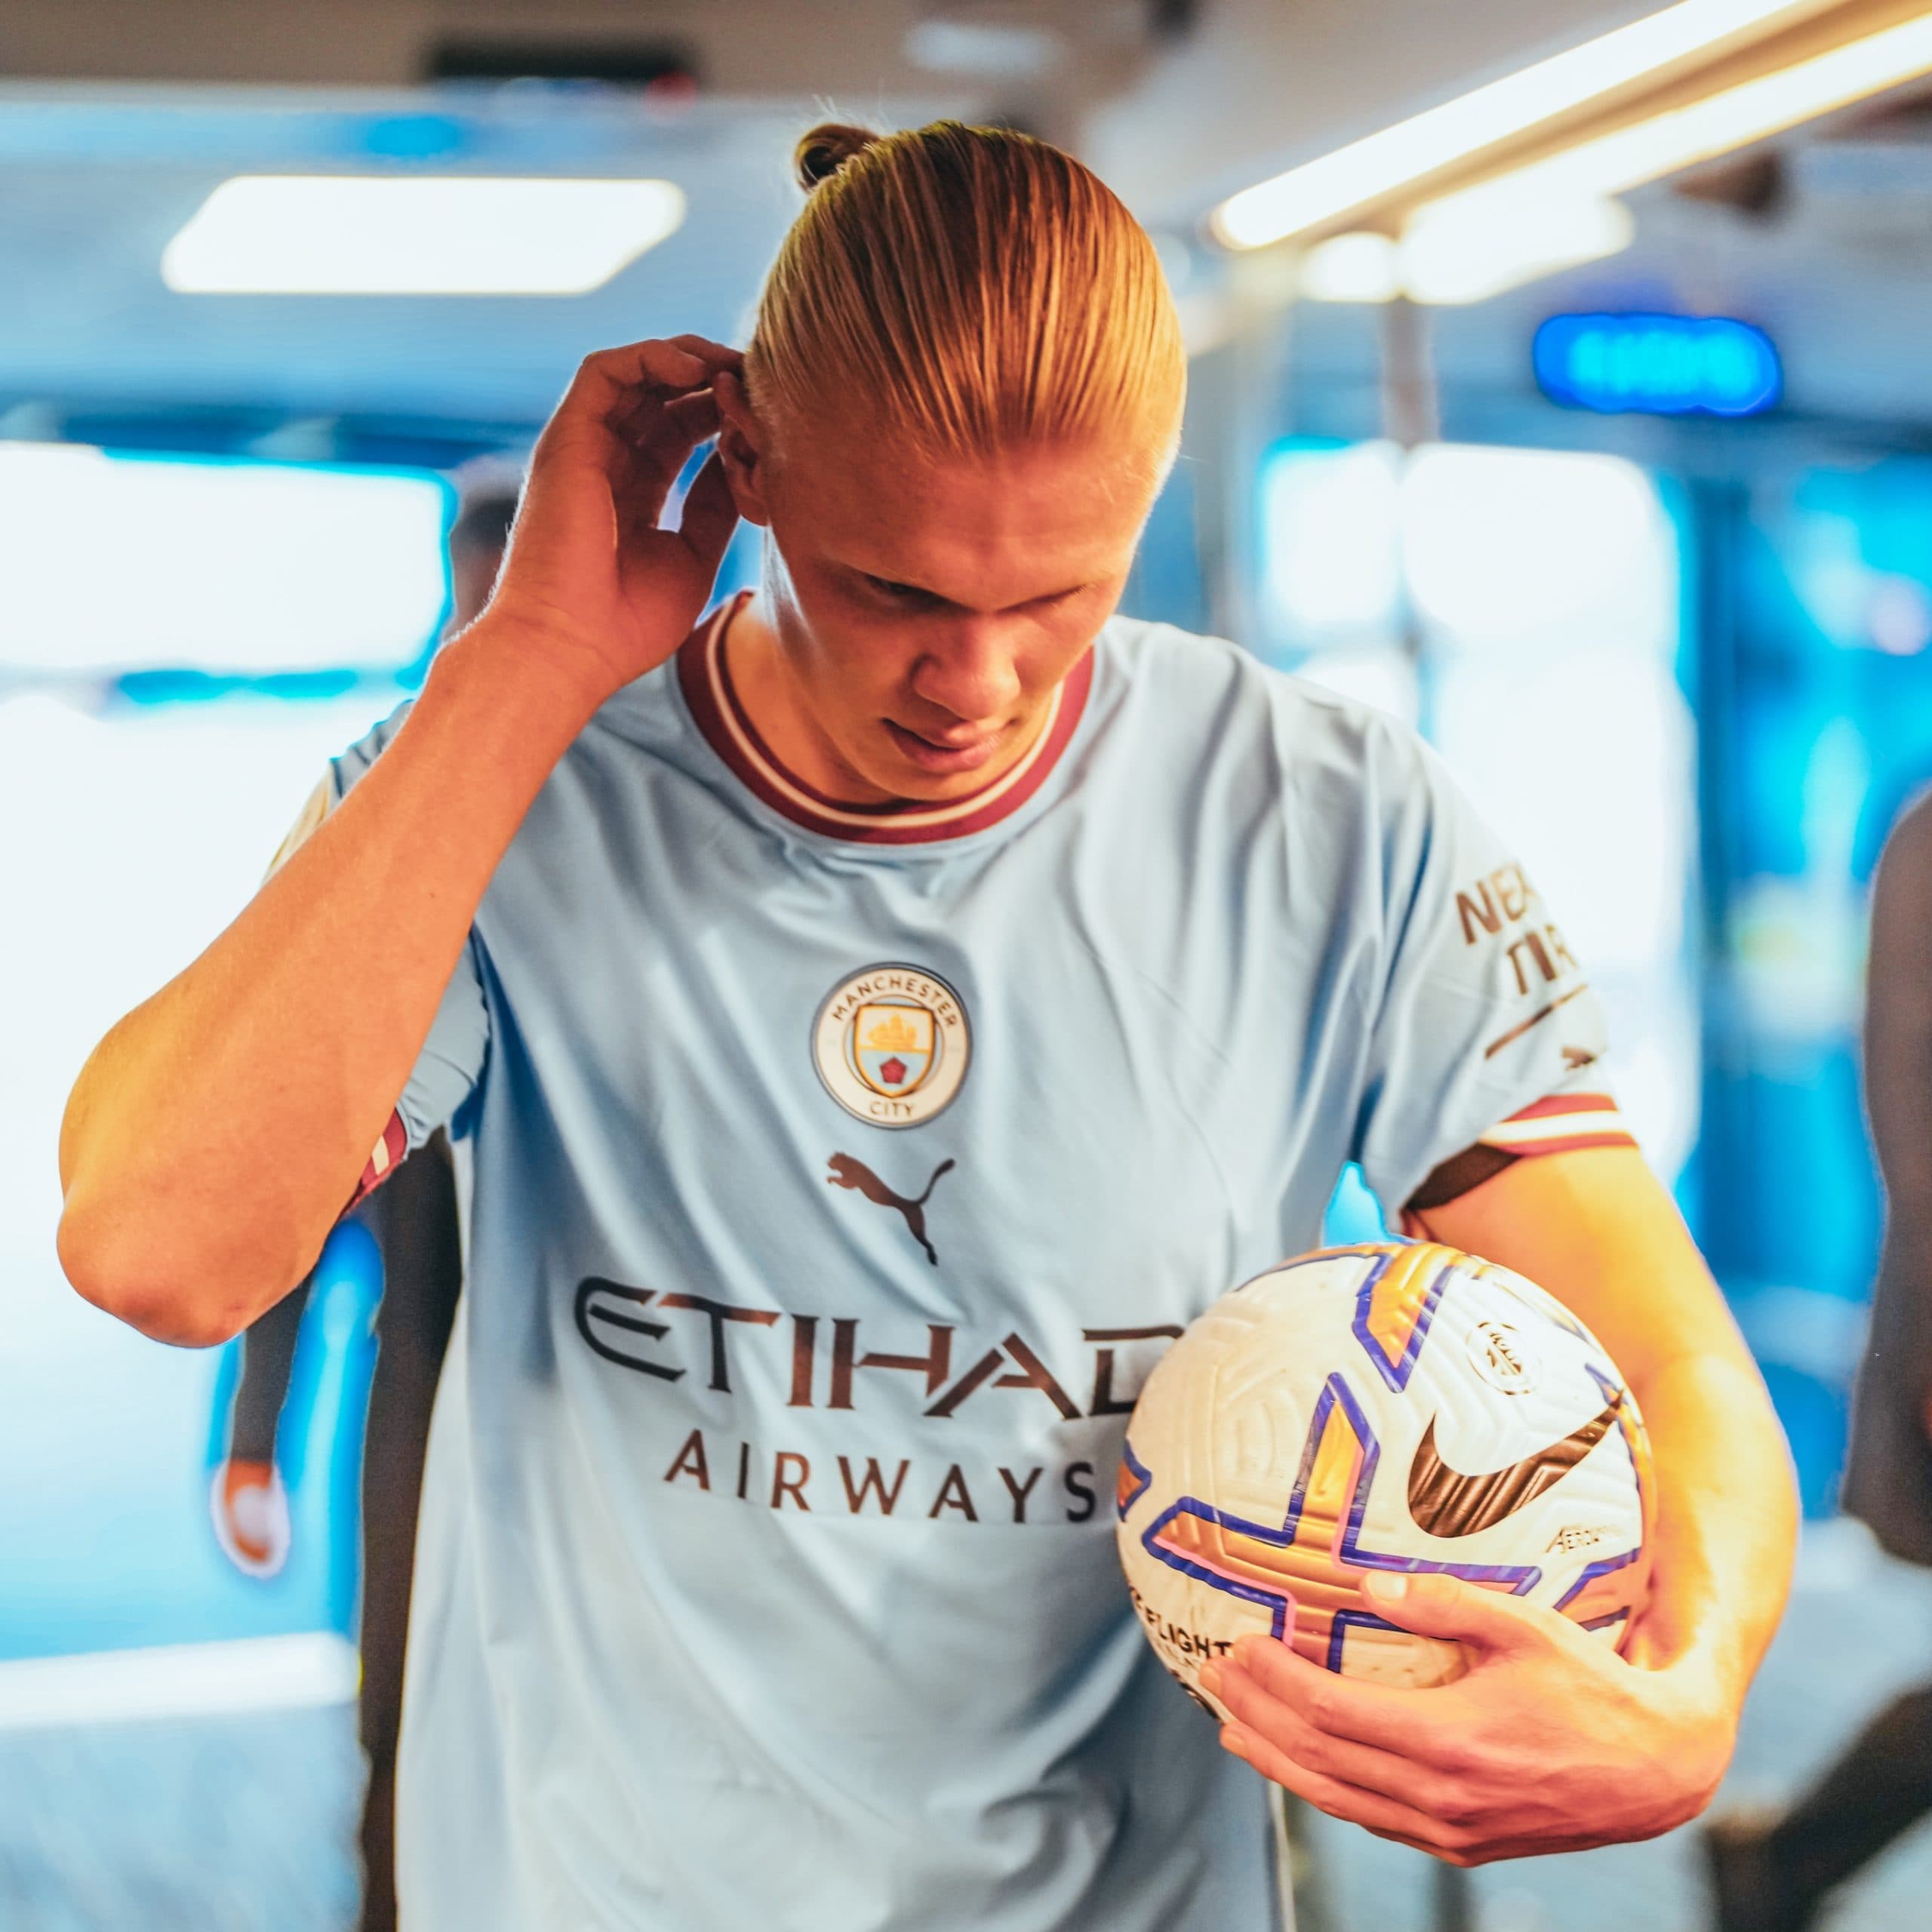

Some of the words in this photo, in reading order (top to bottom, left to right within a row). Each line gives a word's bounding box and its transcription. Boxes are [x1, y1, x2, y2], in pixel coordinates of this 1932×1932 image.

[832, 976, 958, 1027] MANCHESTER
[869, 1101, 915, 1118] CITY
[574, 1275, 1185, 1420] ETIHAD
[663, 1428, 1097, 1523] AIRWAYS
[1145, 1605, 1233, 1660] FLIGHT
